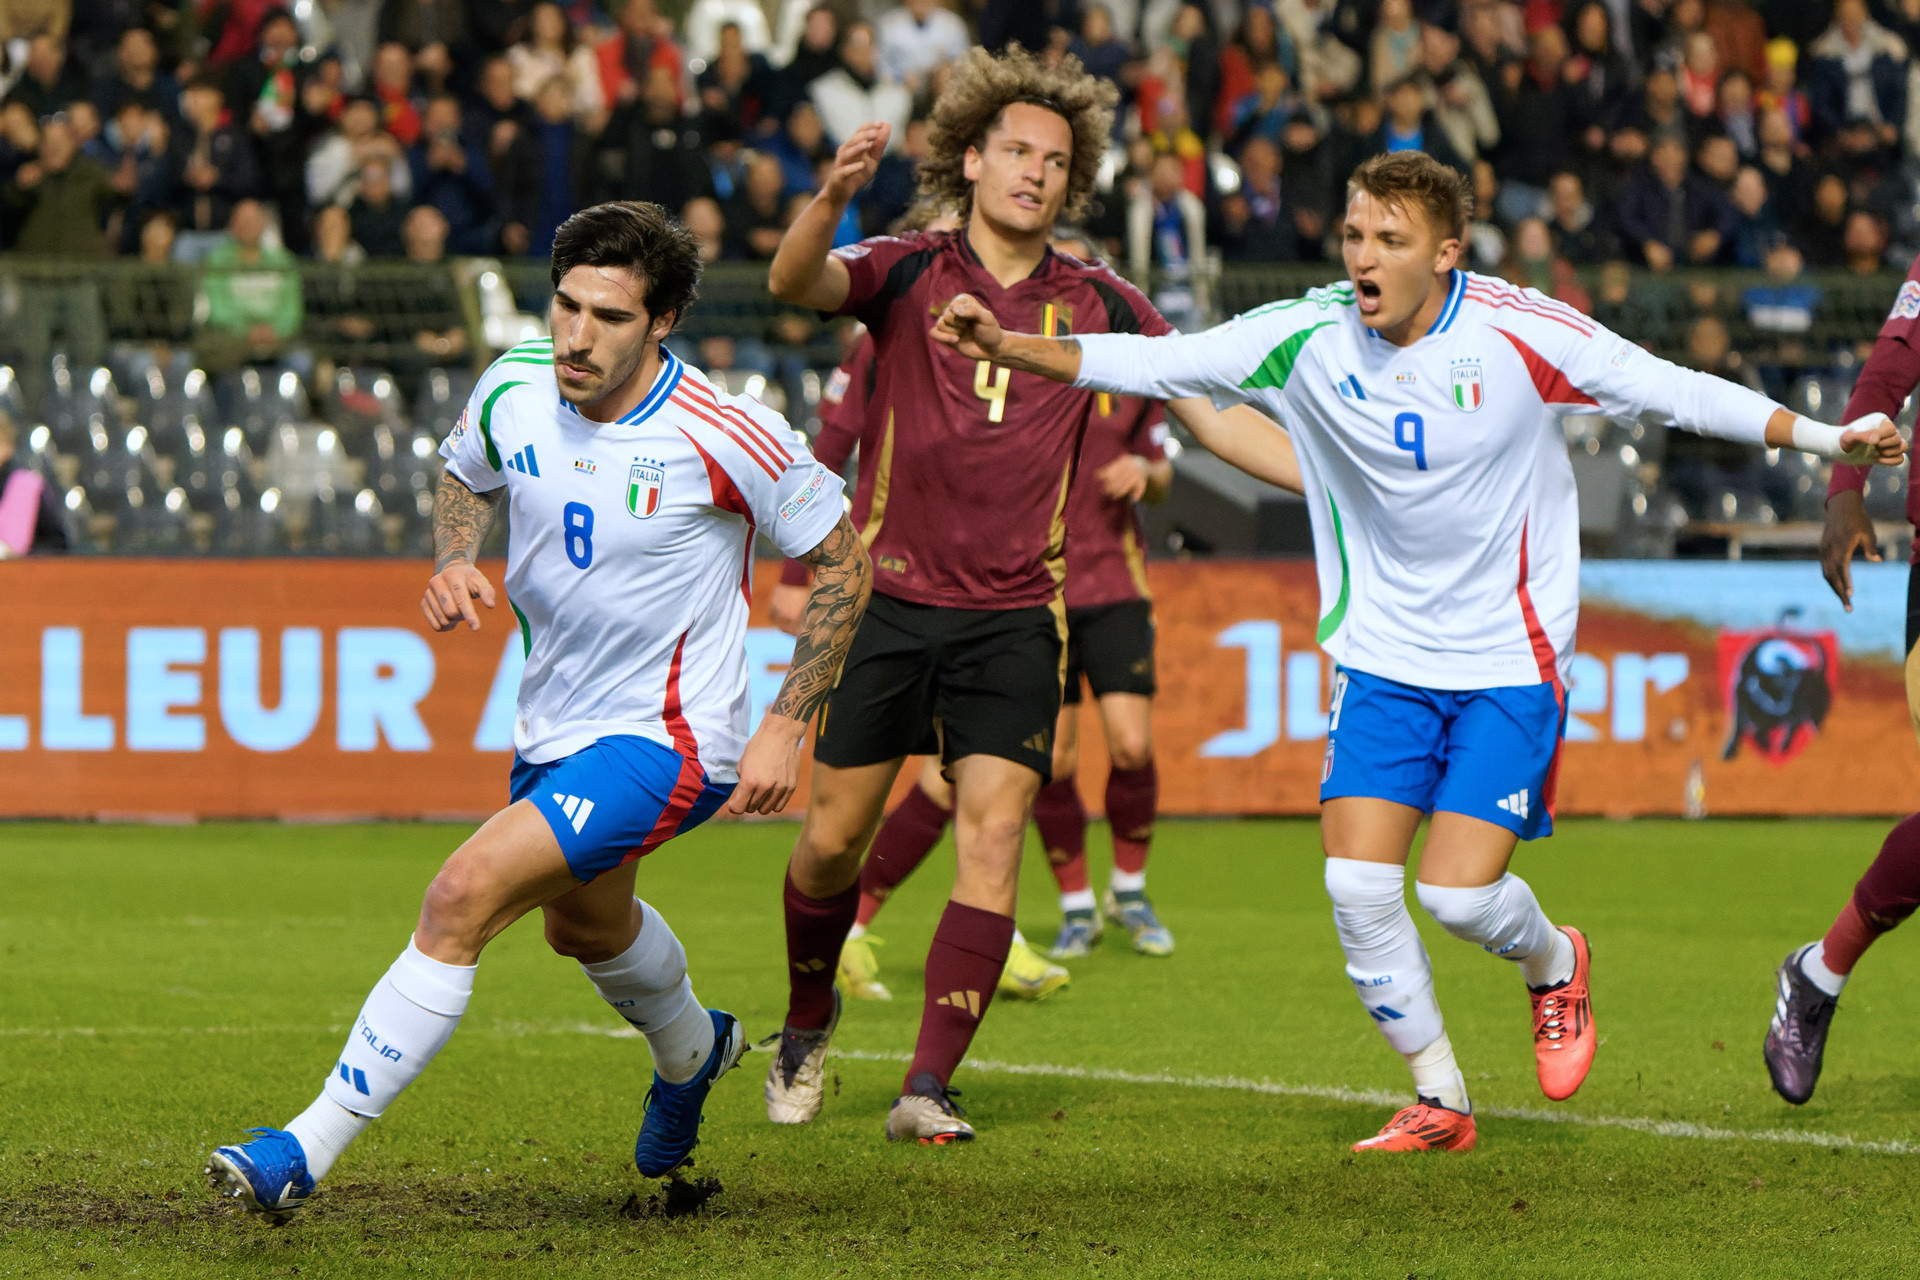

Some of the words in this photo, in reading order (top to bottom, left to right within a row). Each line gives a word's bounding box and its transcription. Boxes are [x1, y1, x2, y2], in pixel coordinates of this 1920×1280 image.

[974, 360, 1011, 423] 4
[1453, 369, 1480, 380] ITALIA
[1394, 412, 1429, 471] 9
[632, 468, 661, 484] ITALIA
[563, 500, 595, 570] 8
